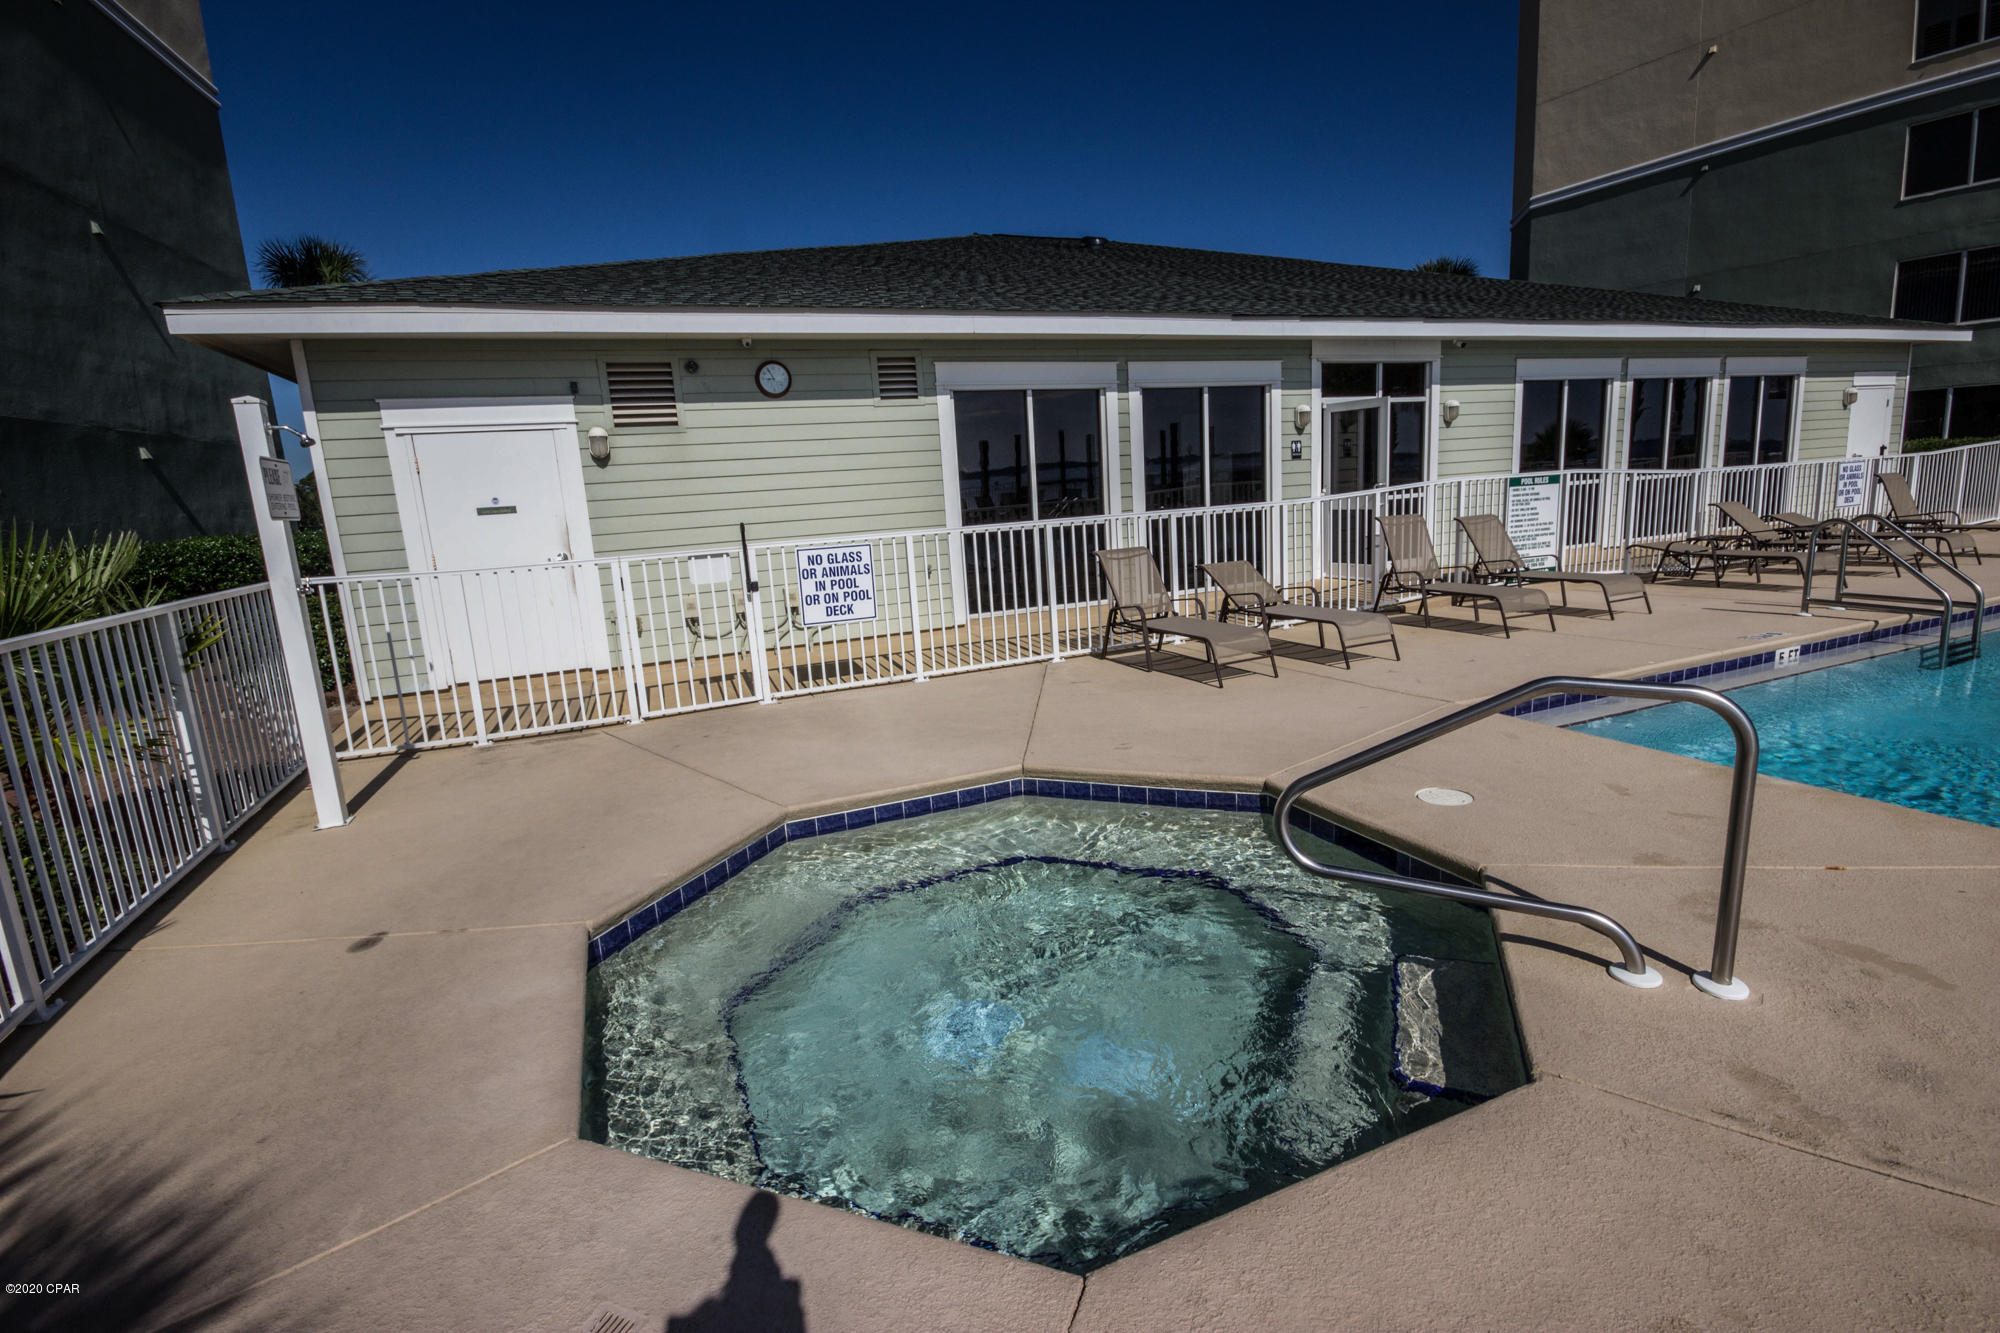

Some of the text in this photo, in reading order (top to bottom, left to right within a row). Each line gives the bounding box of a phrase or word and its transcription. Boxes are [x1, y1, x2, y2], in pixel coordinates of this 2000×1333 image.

[1521, 476, 1550, 486] POOL RULES
[1848, 480, 1858, 488] POOL
[1851, 488, 1862, 496] POOL
[807, 551, 862, 566] NO GLASS
[801, 563, 870, 580] OR ANIMALS
[815, 578, 860, 592] IN POOL
[805, 589, 872, 606] OR ON POOL
[826, 604, 854, 617] DECK
